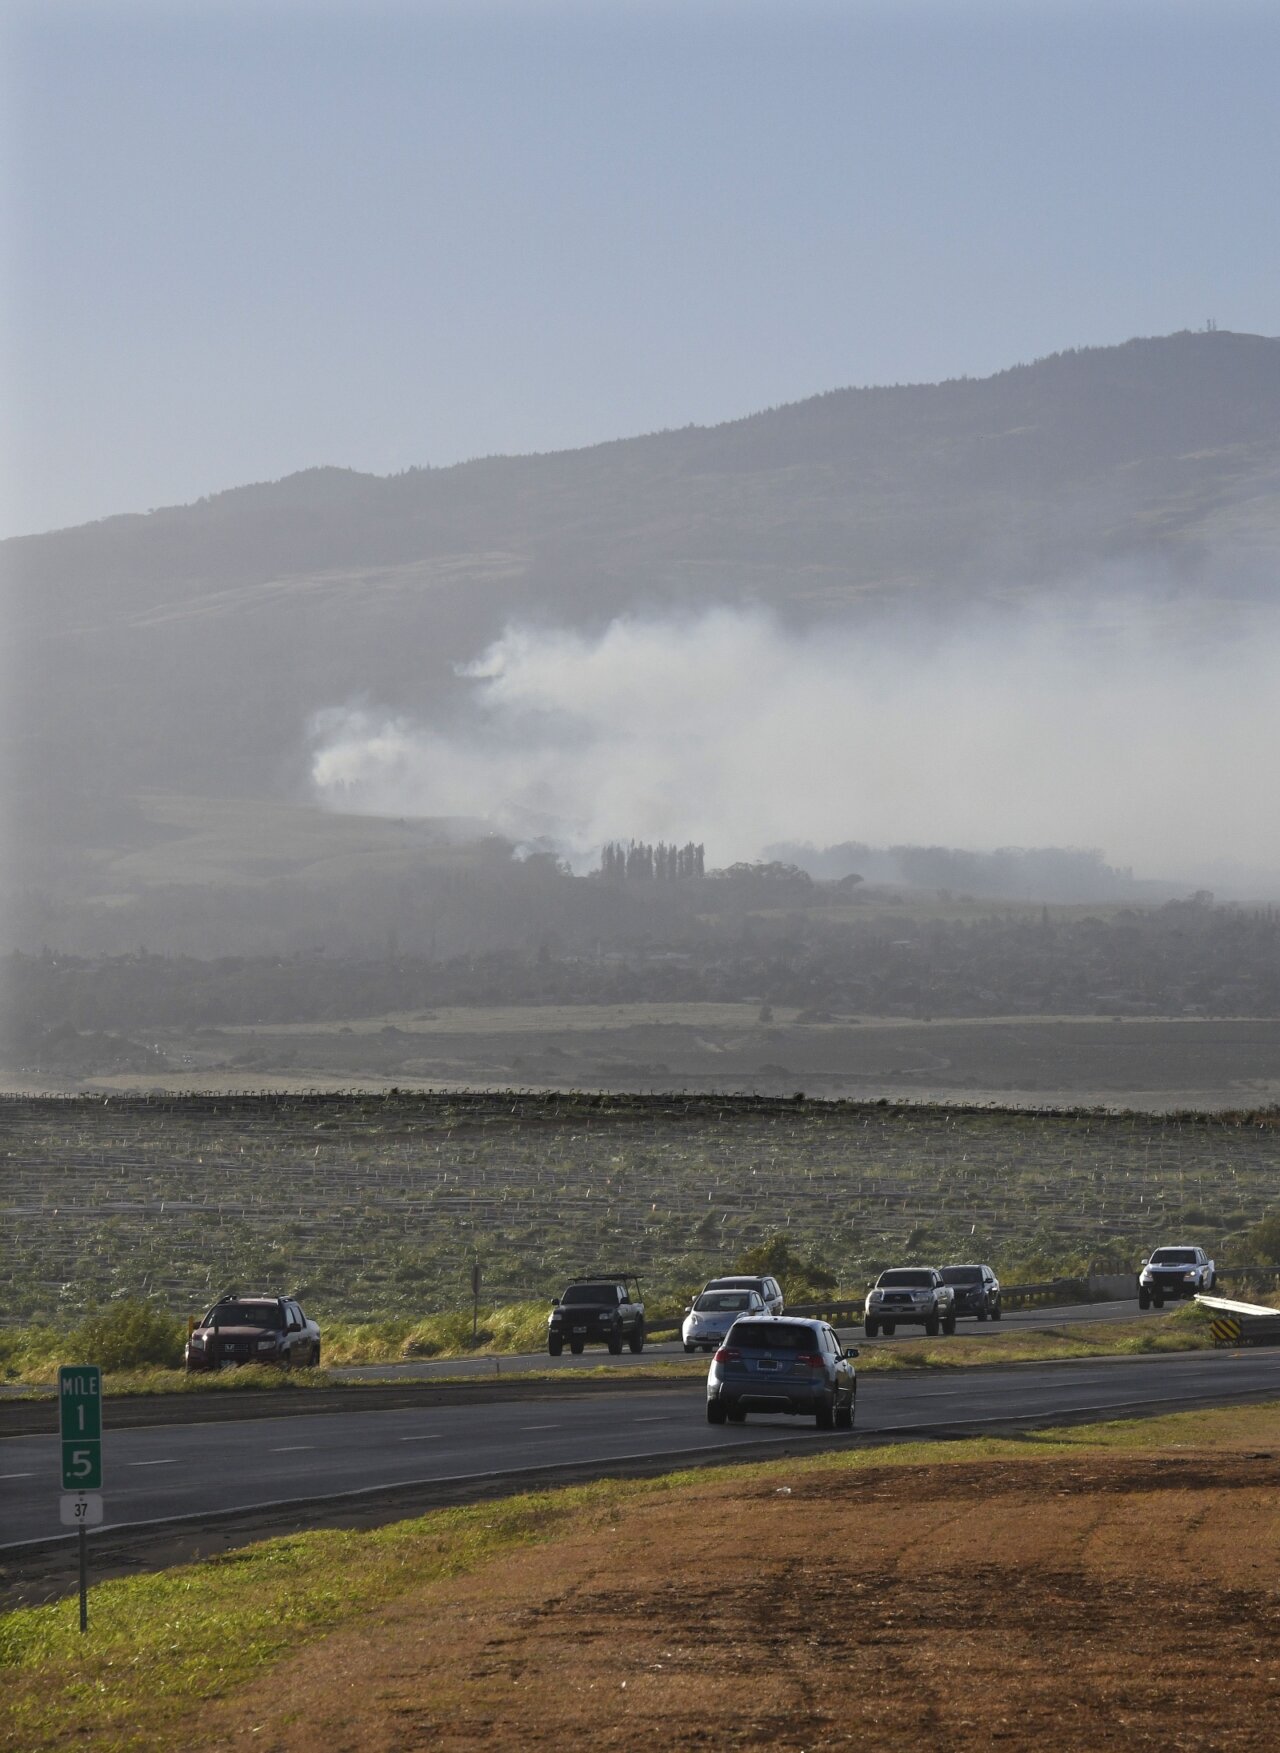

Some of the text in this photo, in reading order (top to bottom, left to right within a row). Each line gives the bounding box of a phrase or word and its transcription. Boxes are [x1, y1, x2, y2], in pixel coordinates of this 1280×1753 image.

[62, 1377, 97, 1395] MILE
[76, 1404, 85, 1431] 1
[74, 1503, 88, 1517] 37
